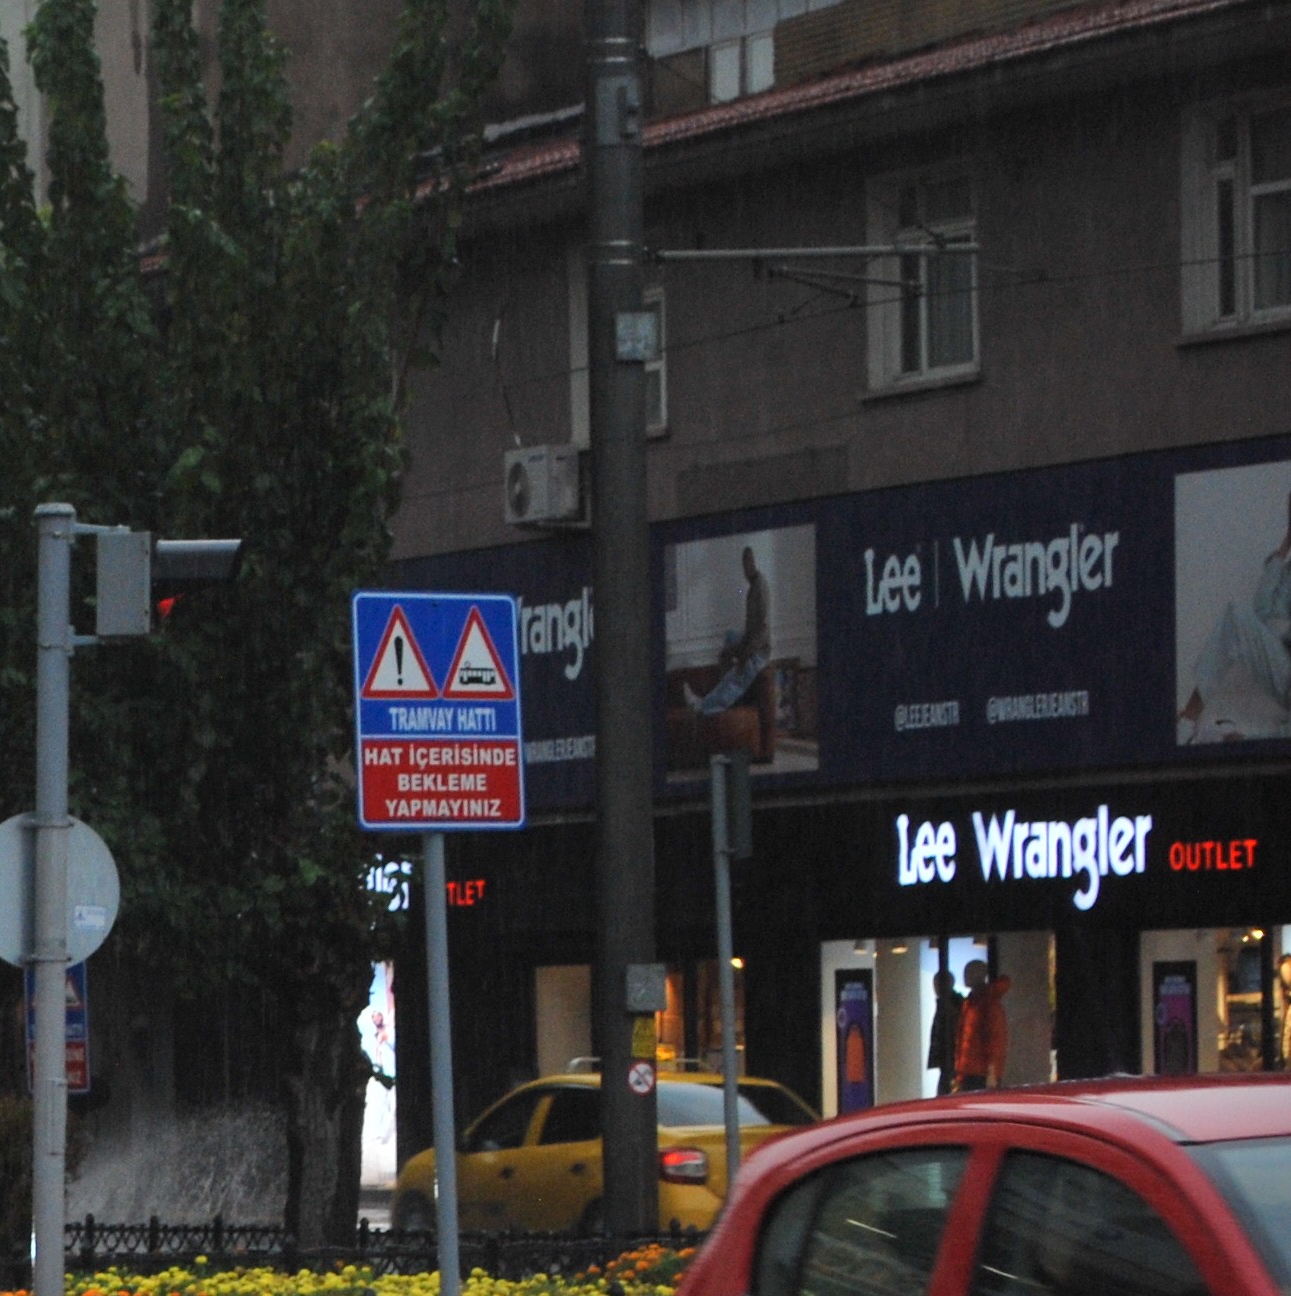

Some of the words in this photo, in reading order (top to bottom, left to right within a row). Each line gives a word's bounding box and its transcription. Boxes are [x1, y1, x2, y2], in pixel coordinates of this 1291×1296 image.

[864, 548, 921, 616] Lee
[953, 523, 1119, 628] Wrangler
[389, 707, 454, 732] TRAMVAY
[457, 708, 496, 732] HATTI
[364, 748, 403, 766] HAT
[408, 744, 516, 769] İÇERİSİNDE
[398, 773, 487, 792] BEKLEME
[386, 799, 501, 817] YAPMAYINIZ
[896, 813, 957, 886] Lee
[972, 804, 1153, 911] Wrangler
[1169, 839, 1257, 871] OUTLET
[446, 880, 486, 906] TLET
